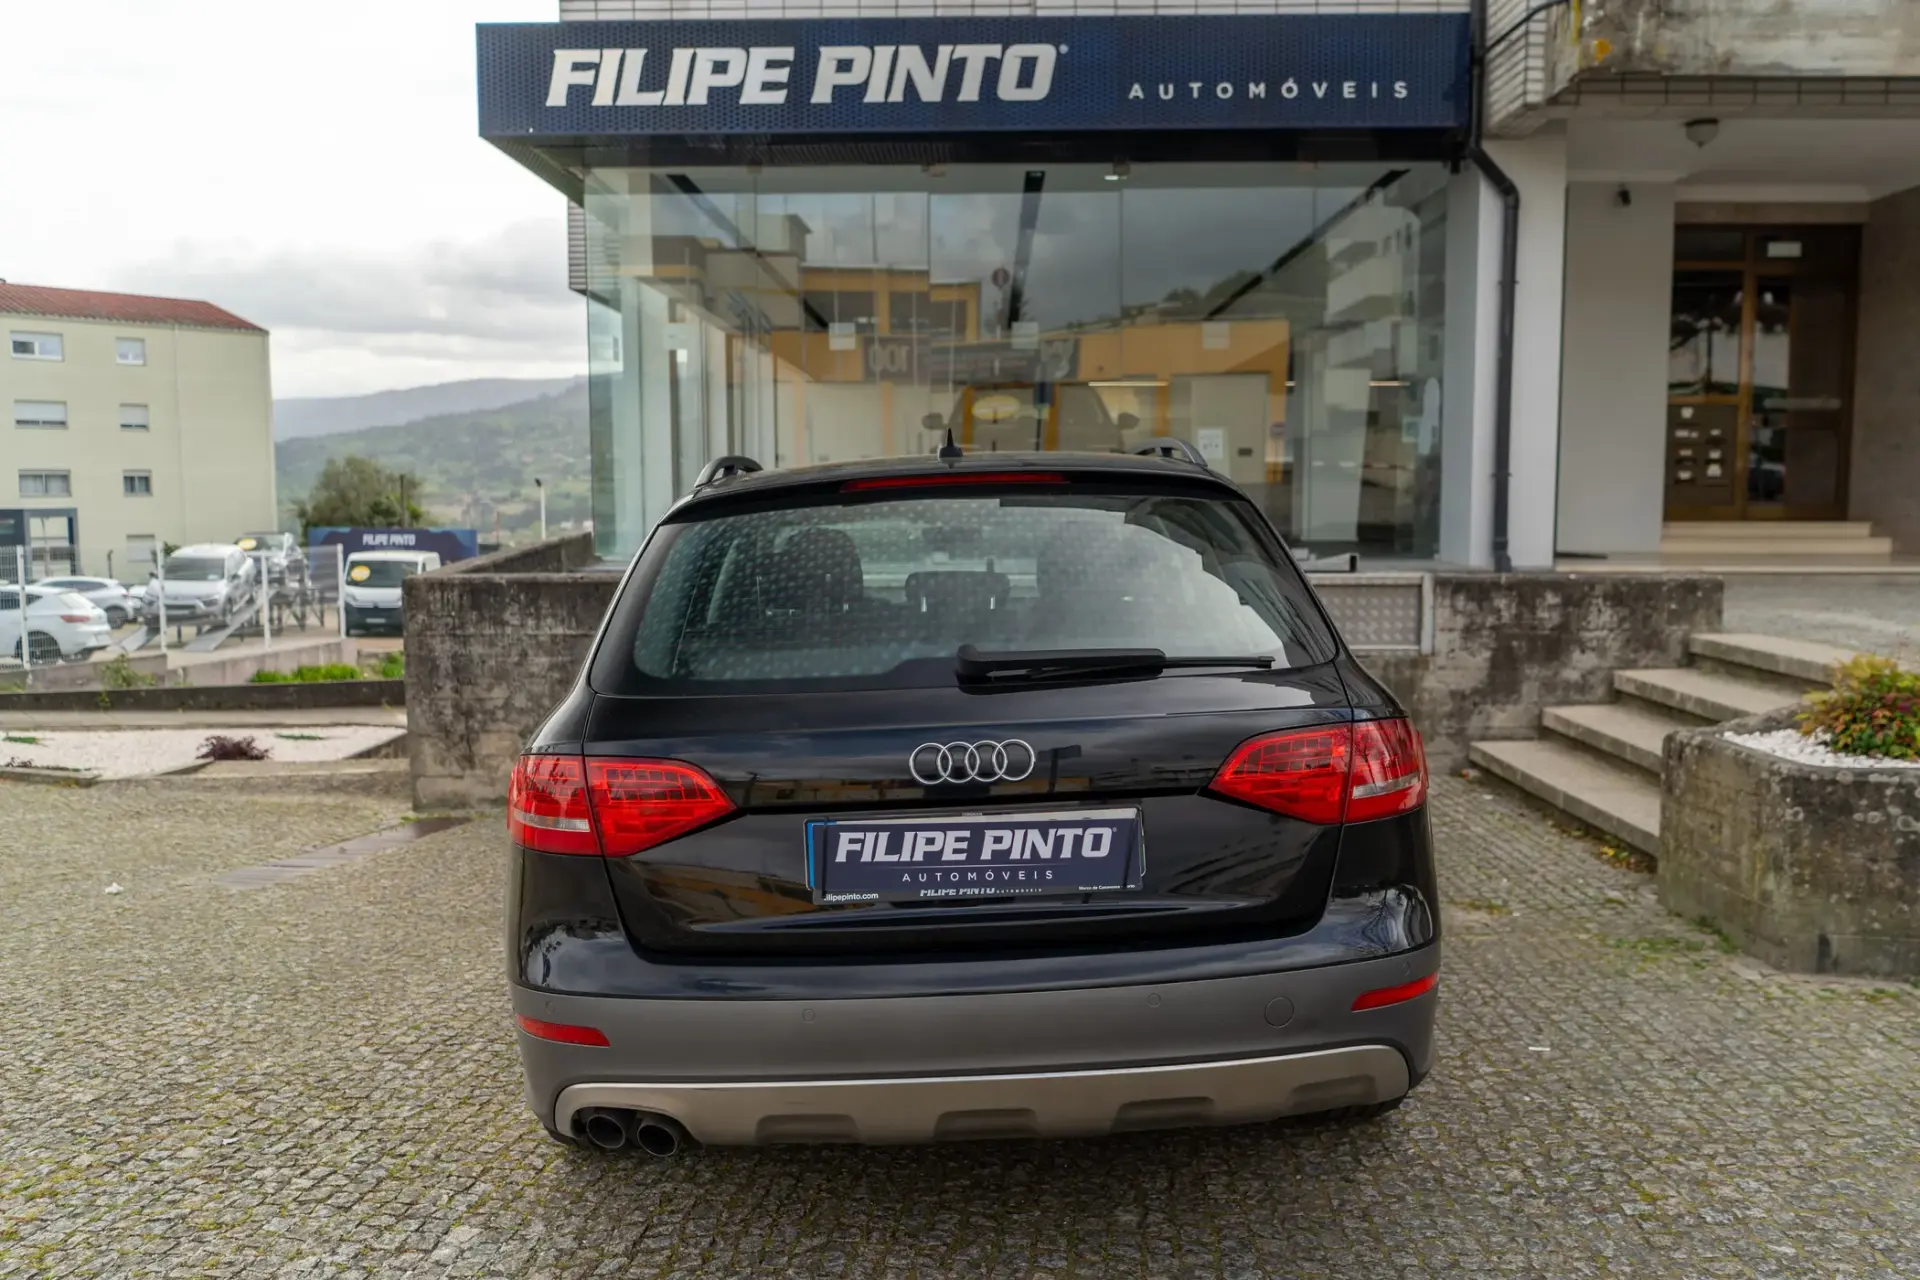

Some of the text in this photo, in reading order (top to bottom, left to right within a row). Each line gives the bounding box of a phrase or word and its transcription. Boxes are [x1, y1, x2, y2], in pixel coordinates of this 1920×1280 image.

[545, 46, 795, 107] FILIPE
[1128, 77, 1408, 100] AUTOMÓVEIS
[362, 533, 416, 546] FILIPE PINTO
[834, 830, 971, 863] FILIPE
[902, 869, 1053, 883] AUTOMÓVEIS
